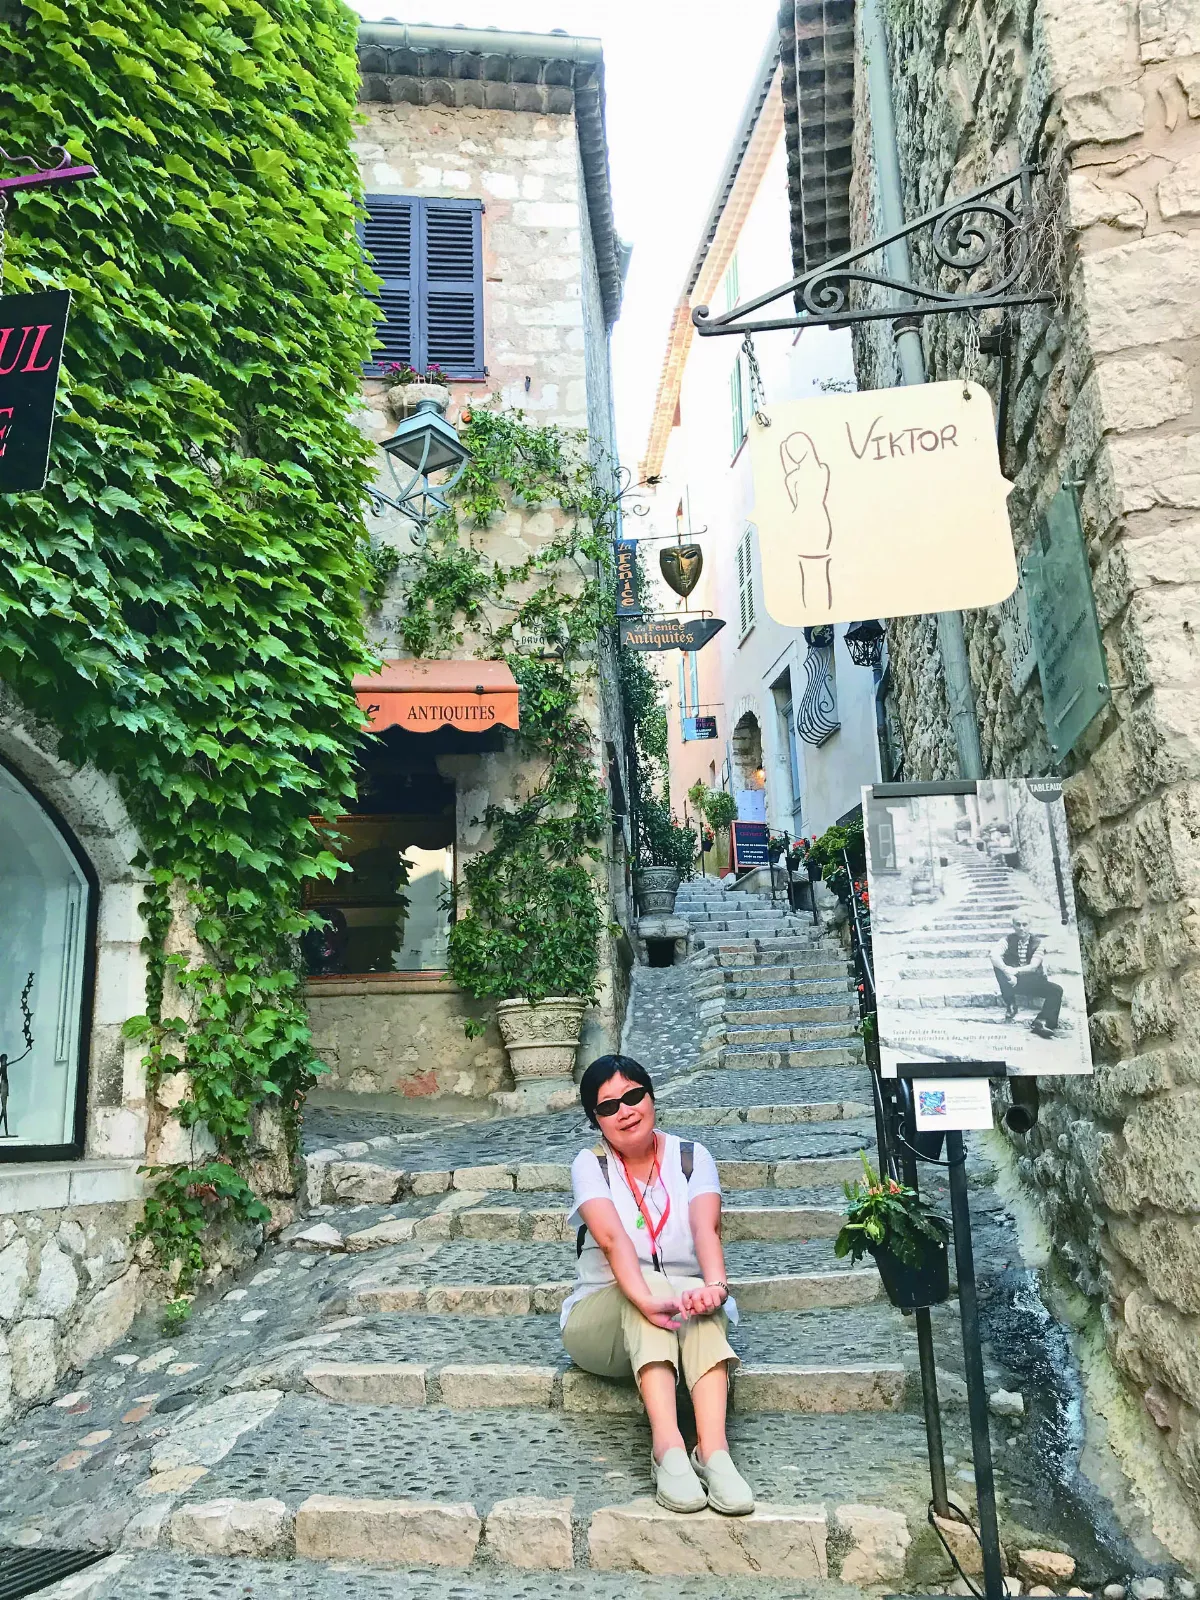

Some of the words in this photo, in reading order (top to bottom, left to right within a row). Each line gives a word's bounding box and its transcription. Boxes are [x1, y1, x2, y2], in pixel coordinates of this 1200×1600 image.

[845, 415, 959, 460] VIKTOR
[618, 542, 631, 551] La
[617, 552, 635, 607] Fenice
[648, 622, 686, 632] Fenice
[623, 631, 694, 648] Antiquités
[407, 705, 495, 721] ANTIQUITES
[1030, 783, 1062, 792] TABLEAUX
